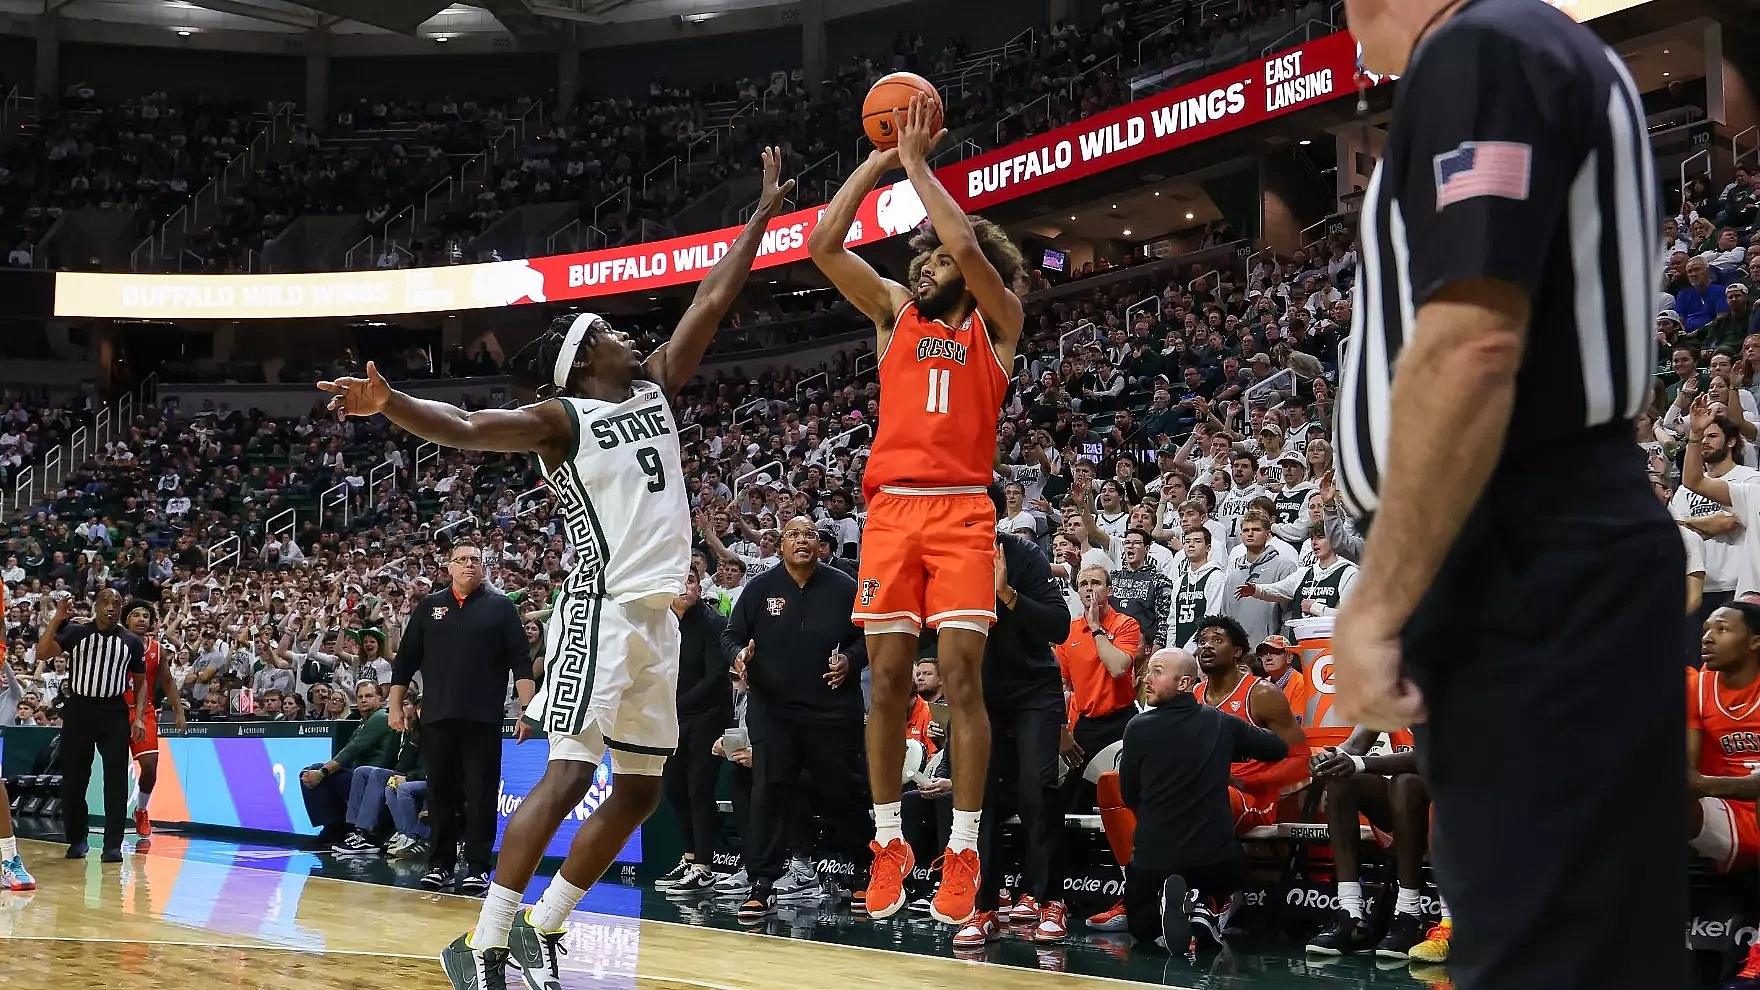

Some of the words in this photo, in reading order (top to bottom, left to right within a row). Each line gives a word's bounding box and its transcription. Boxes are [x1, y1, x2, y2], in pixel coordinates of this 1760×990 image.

[1265, 51, 1303, 85] EAST
[1266, 69, 1332, 112] LANSING
[1692, 131, 1710, 145] 110
[967, 140, 1072, 198] BUFFALO
[1079, 117, 1145, 162] WILD
[568, 252, 667, 288] BUFFALO
[673, 240, 728, 273] WILD
[122, 284, 236, 307] BUFFALO
[242, 284, 303, 307] WILD
[917, 336, 967, 366] BGSU
[926, 368, 950, 413] 11
[590, 404, 671, 450] STATE
[635, 446, 666, 493] 9
[1179, 604, 1196, 623] 55
[1719, 731, 1760, 755] BGS
[713, 851, 740, 866] ocket
[912, 865, 933, 880] ket
[1064, 876, 1100, 892] ocke
[1304, 889, 1375, 915] Rocet
[1690, 916, 1732, 937] ket
